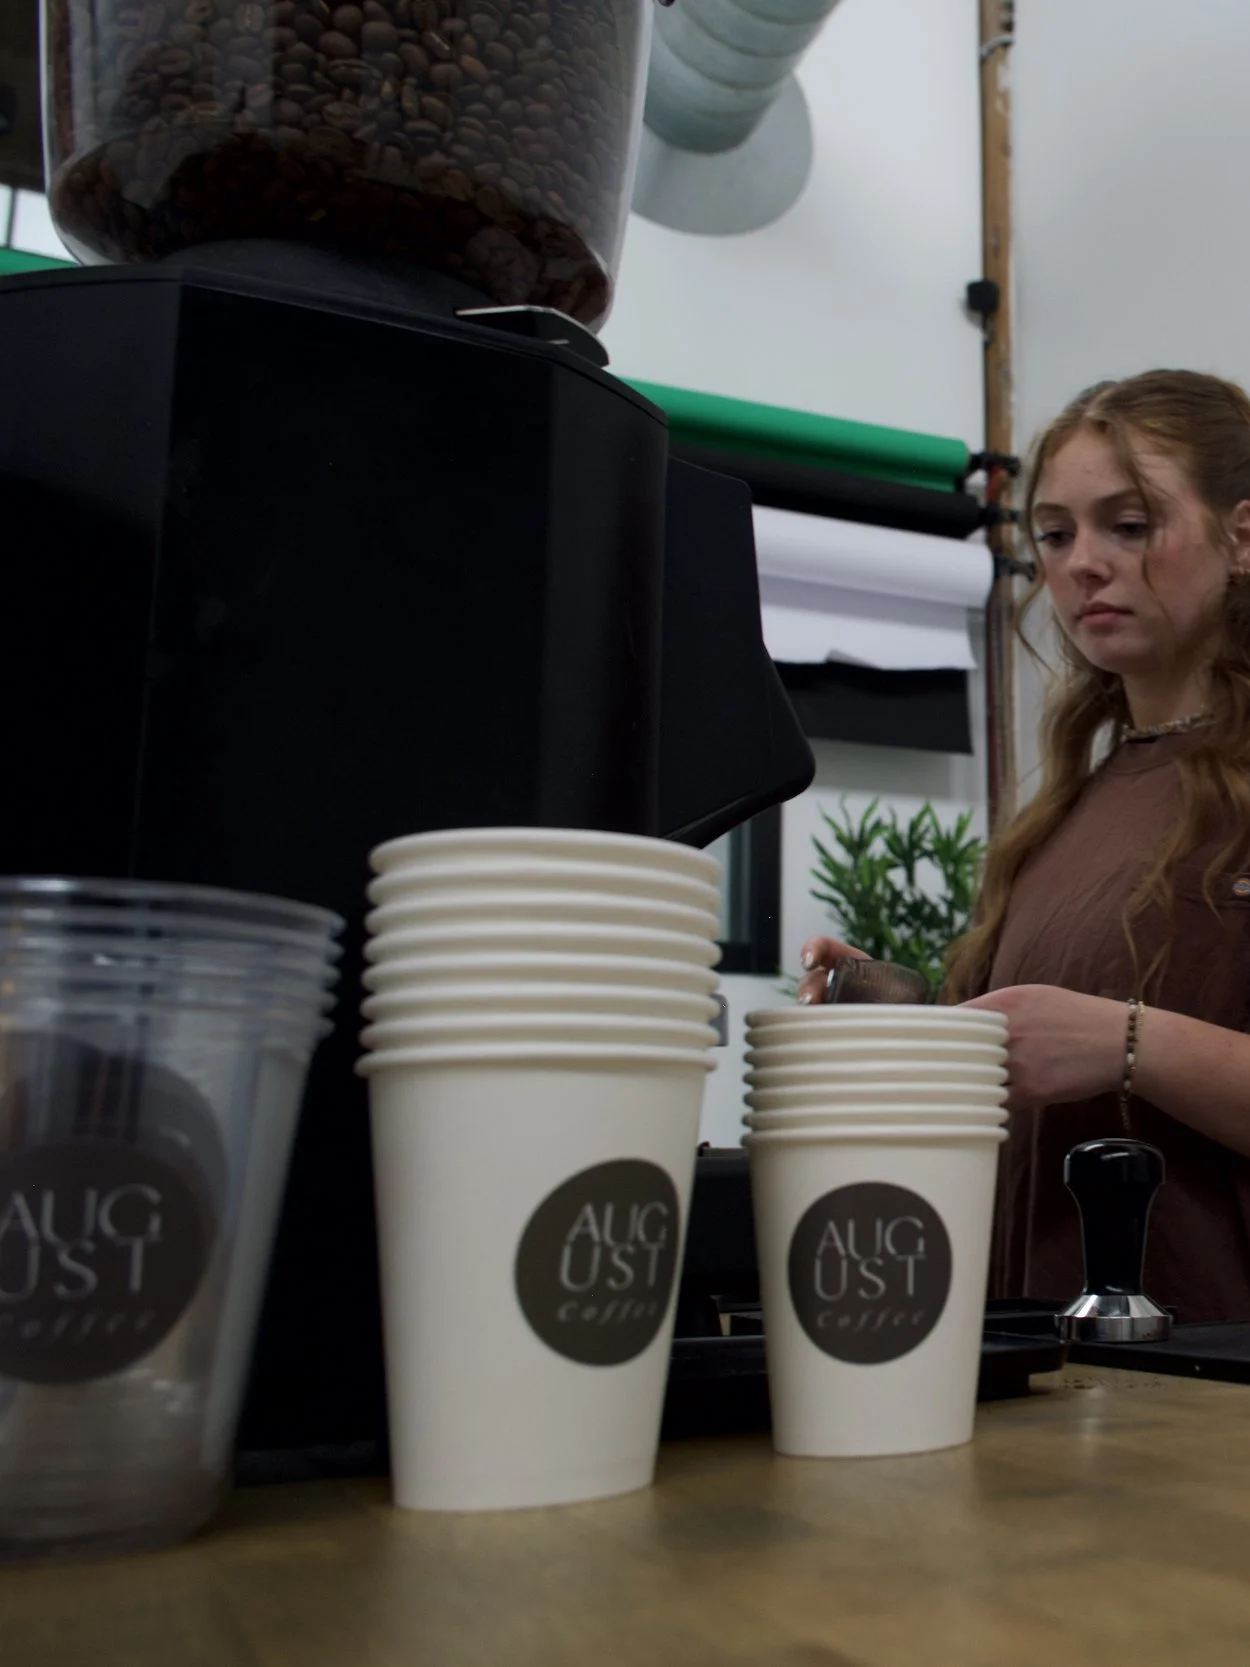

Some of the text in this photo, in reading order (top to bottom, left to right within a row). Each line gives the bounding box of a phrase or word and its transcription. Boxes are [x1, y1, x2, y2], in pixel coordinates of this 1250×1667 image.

[565, 1200, 670, 1250] AUG
[815, 1215, 926, 1260] AUG
[558, 1243, 668, 1292] UST
[813, 1254, 926, 1302] UST
